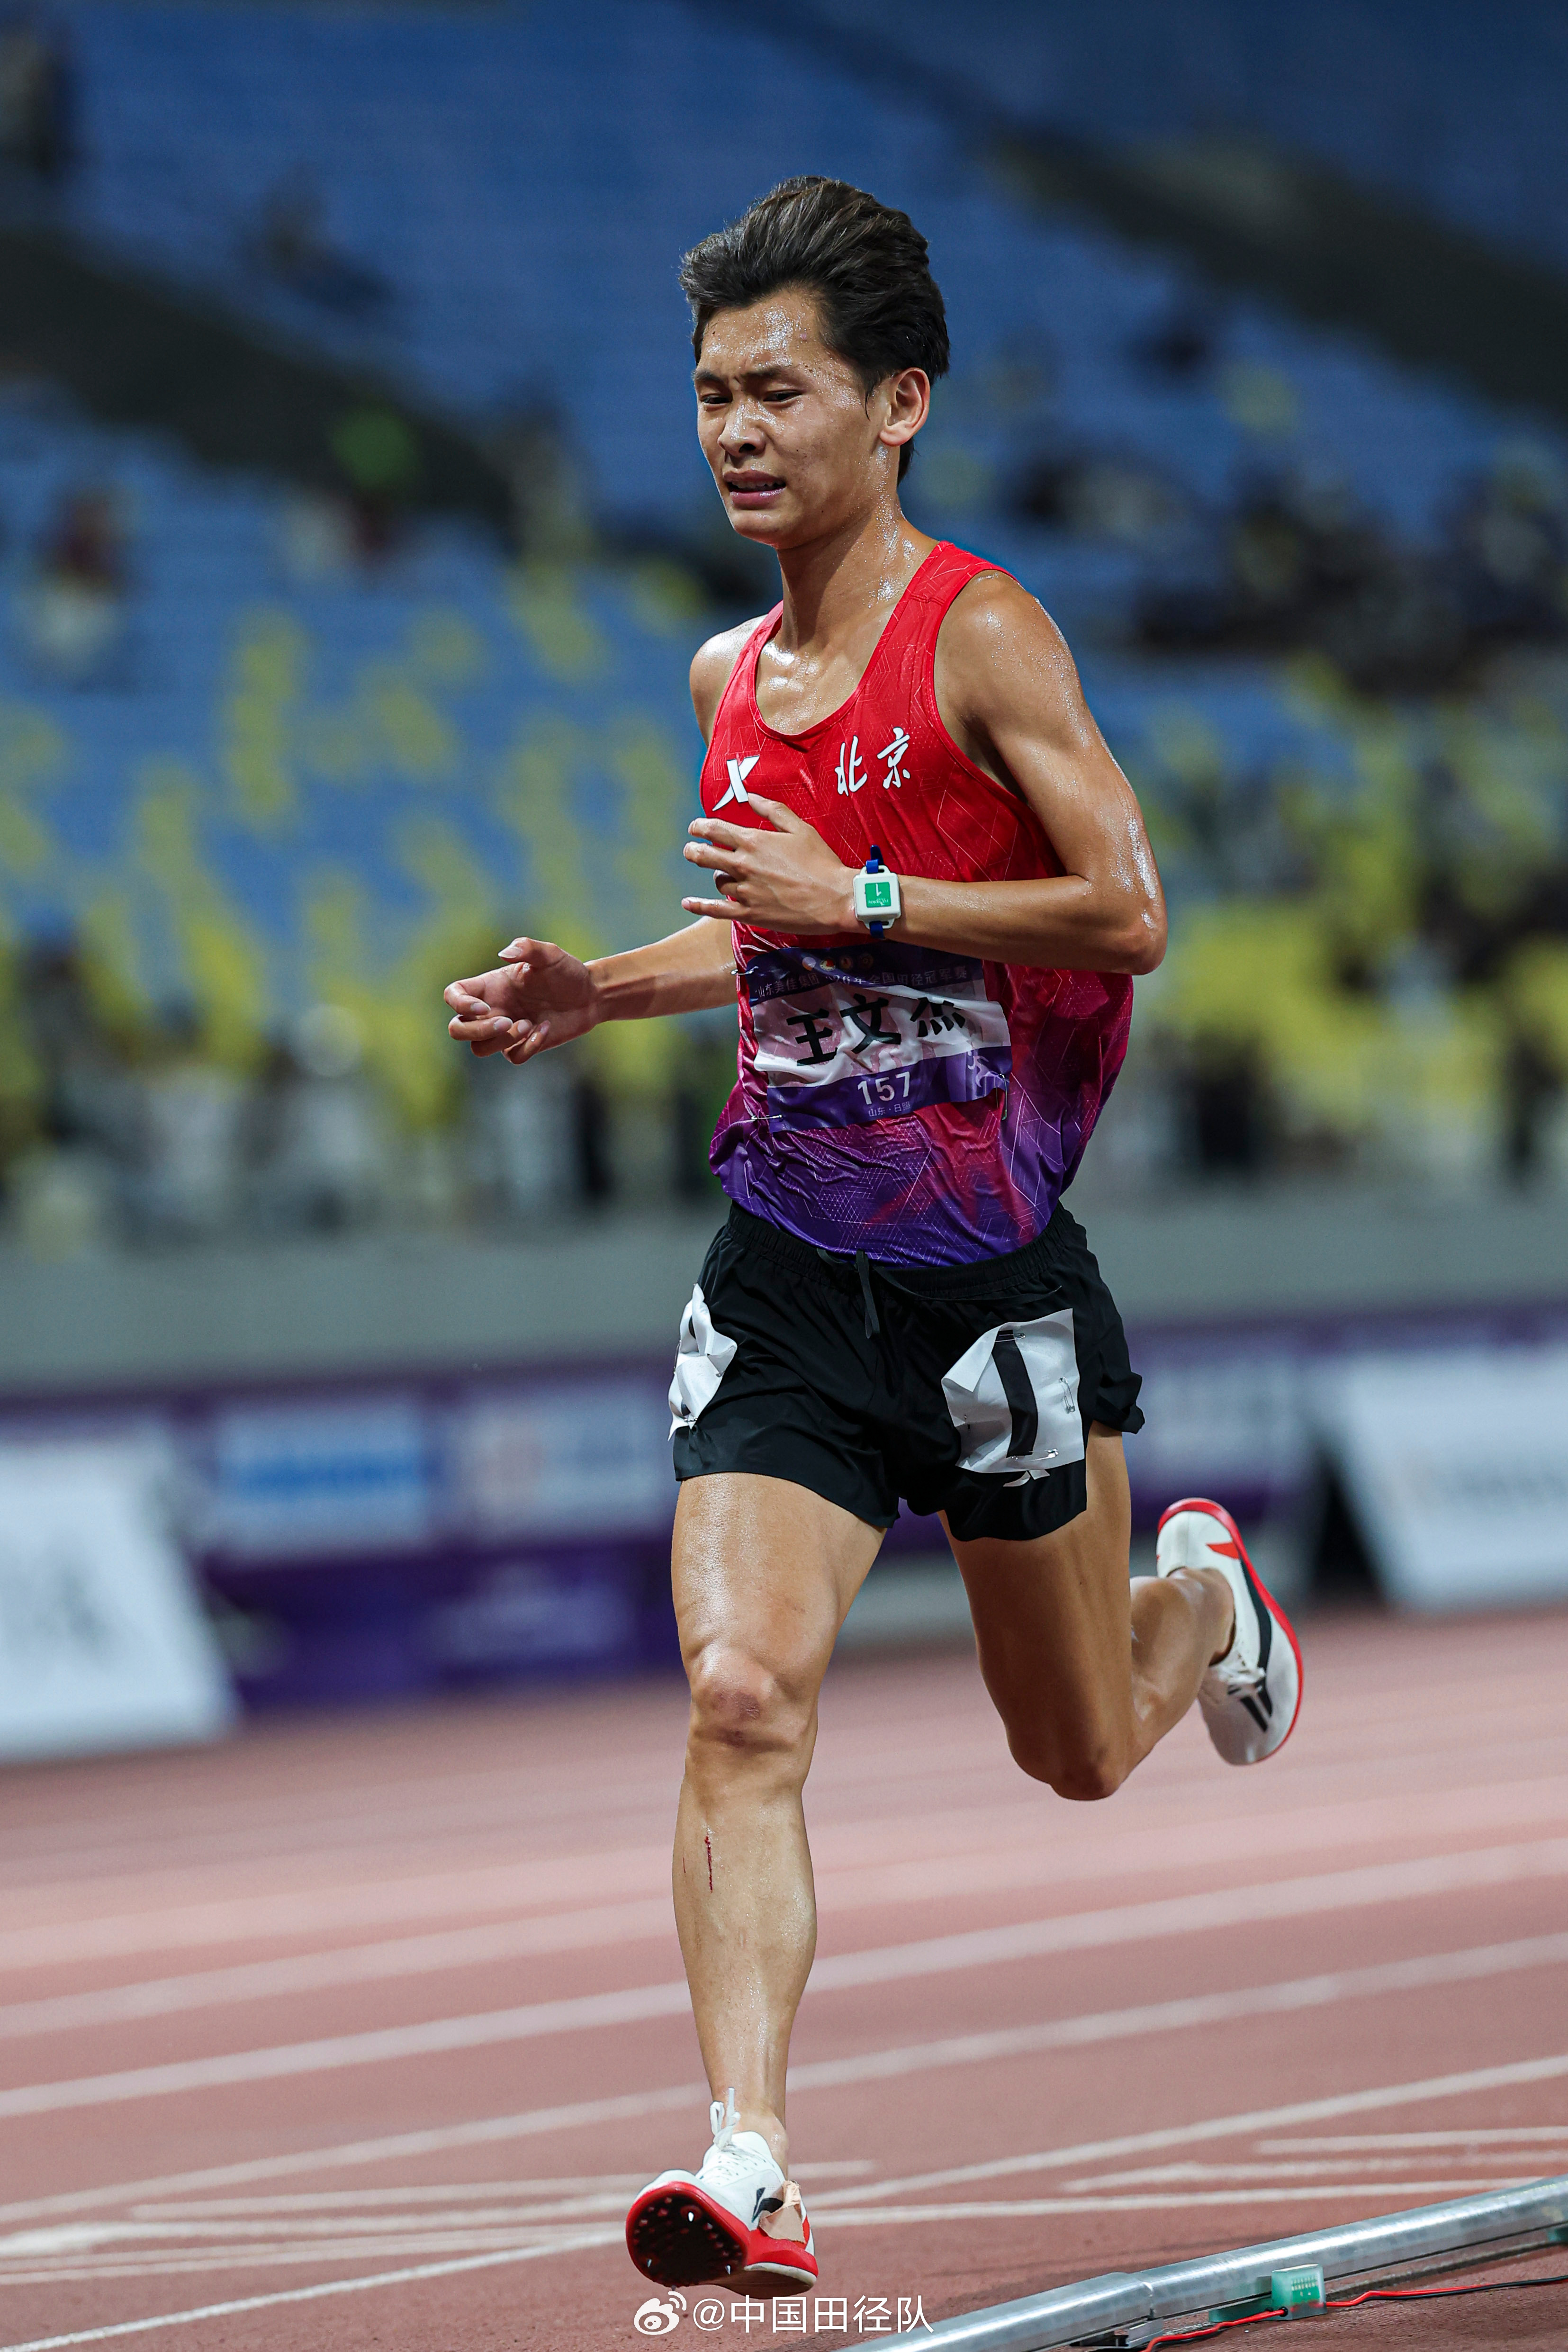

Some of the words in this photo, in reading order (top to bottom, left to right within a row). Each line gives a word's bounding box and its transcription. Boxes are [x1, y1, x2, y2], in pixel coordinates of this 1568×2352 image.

[835, 727, 910, 796] 北京
[786, 993, 965, 1066] 王文杰
[857, 1071, 910, 1105] 157
